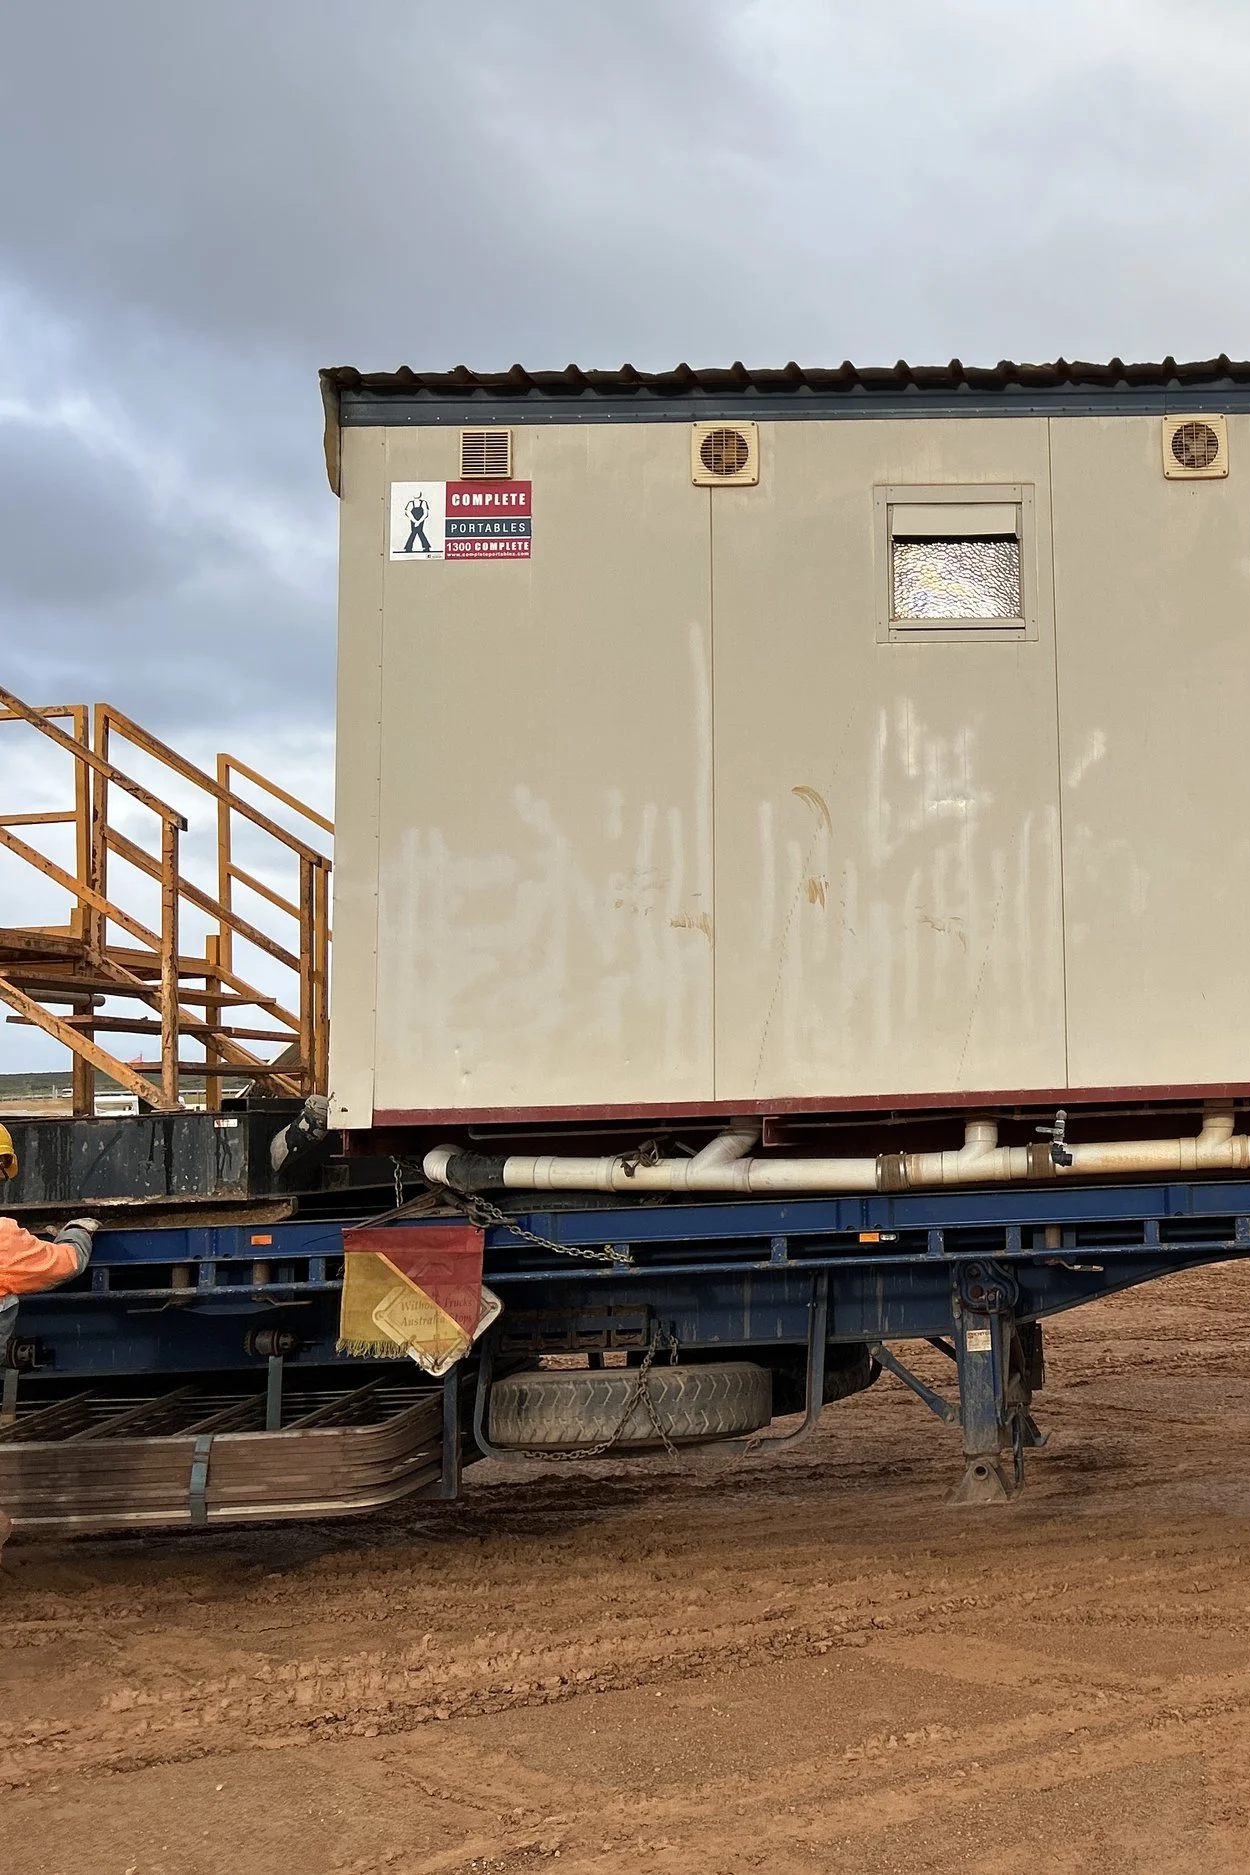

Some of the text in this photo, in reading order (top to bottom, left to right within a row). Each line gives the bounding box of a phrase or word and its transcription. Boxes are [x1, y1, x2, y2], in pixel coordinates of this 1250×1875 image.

[451, 493, 526, 507] COMPLETE
[450, 523, 526, 533] PORTABLES
[446, 542, 529, 552] 1300 COMPLETE
[401, 1299, 438, 1311] Witho
